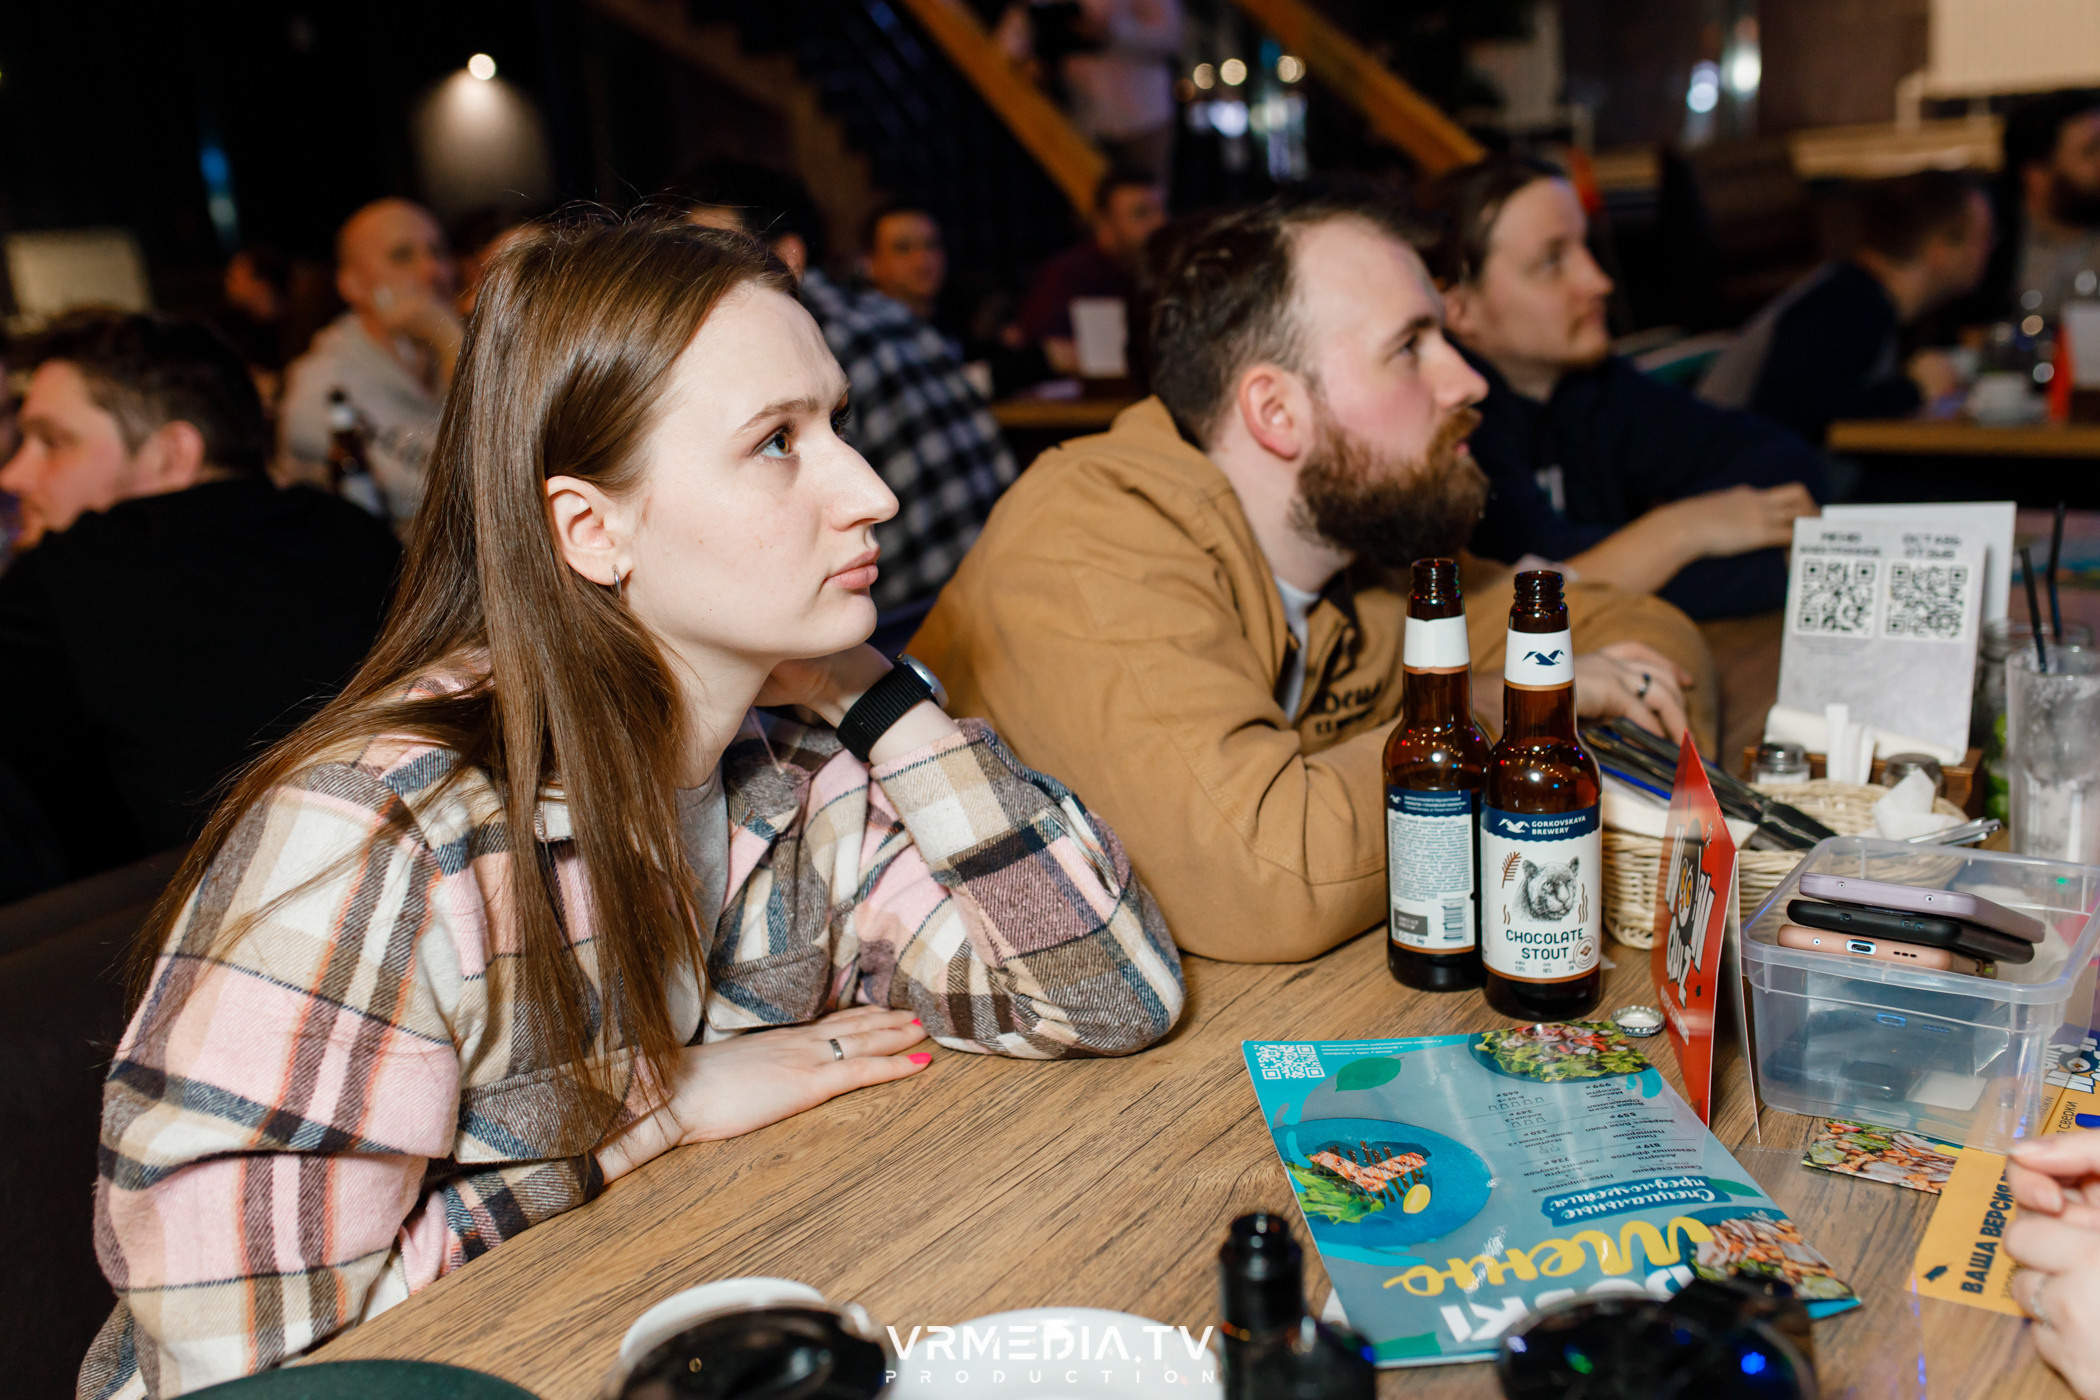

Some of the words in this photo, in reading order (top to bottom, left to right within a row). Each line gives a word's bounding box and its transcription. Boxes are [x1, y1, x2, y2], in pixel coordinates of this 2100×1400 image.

[1532, 815, 1586, 828] GORKOVSKAYA
[1532, 827, 1569, 835] BREWERY
[1506, 928, 1583, 944] CHOCOLATE
[1521, 947, 1569, 960] STOUT
[1549, 1176, 1706, 1211] предложения
[1561, 1189, 1715, 1219] Специальные
[1382, 1216, 1714, 1297] Меню
[1960, 1241, 1998, 1294] ВАША
